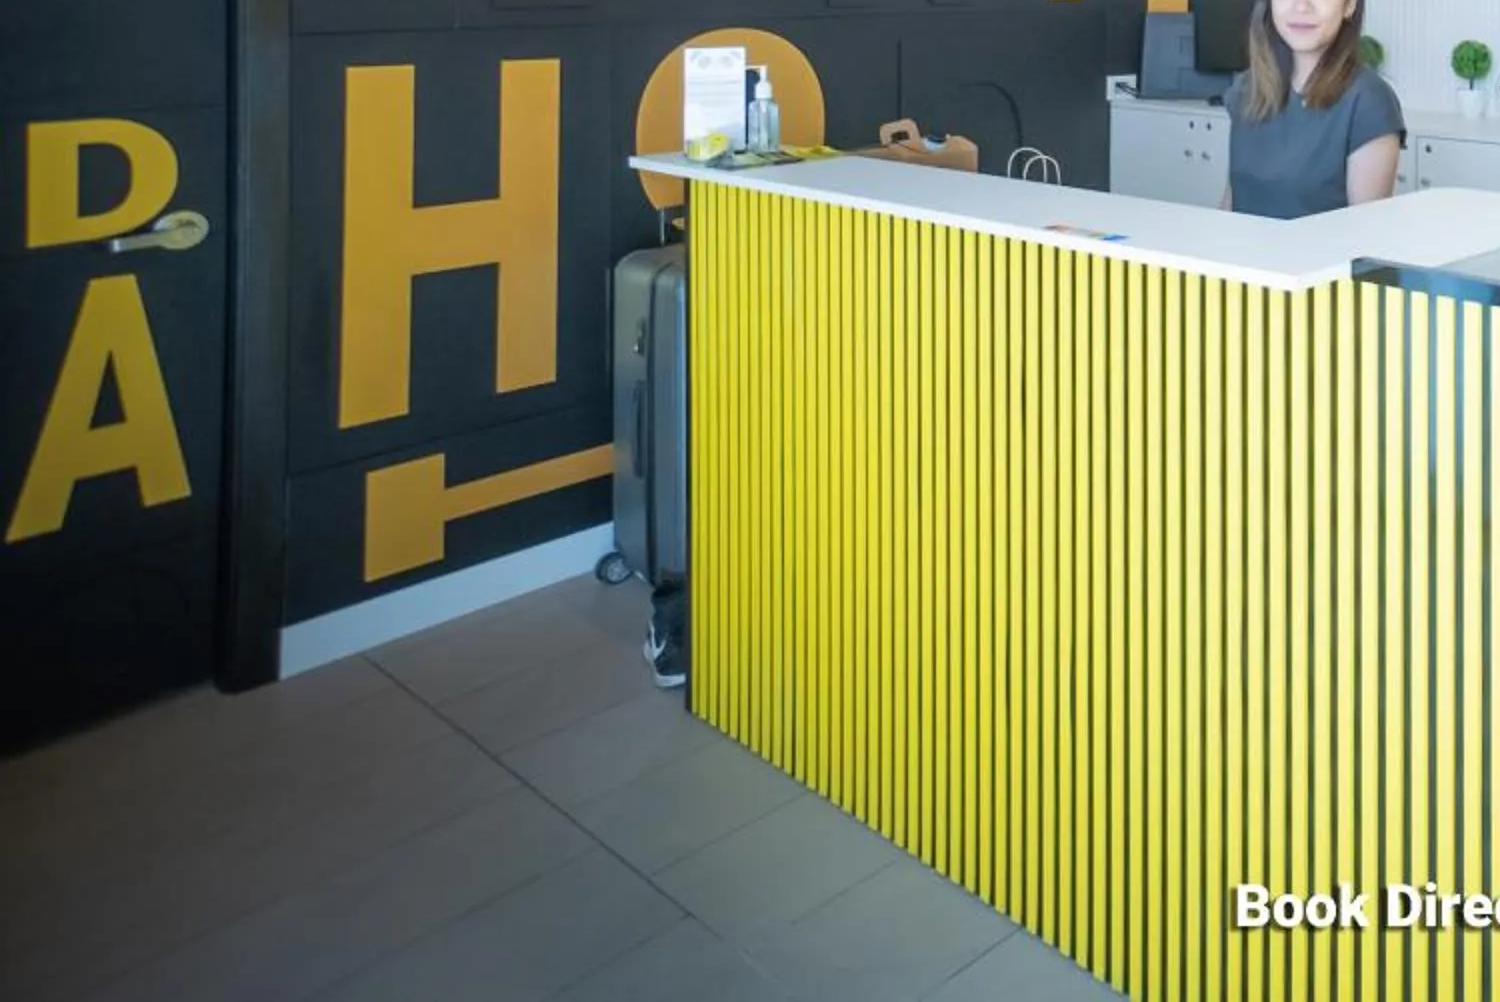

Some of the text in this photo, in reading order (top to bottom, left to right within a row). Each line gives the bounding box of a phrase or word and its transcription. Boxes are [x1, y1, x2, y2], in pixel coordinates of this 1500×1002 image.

[26, 118, 178, 248] D
[338, 58, 561, 429] H
[5, 274, 191, 543] A
